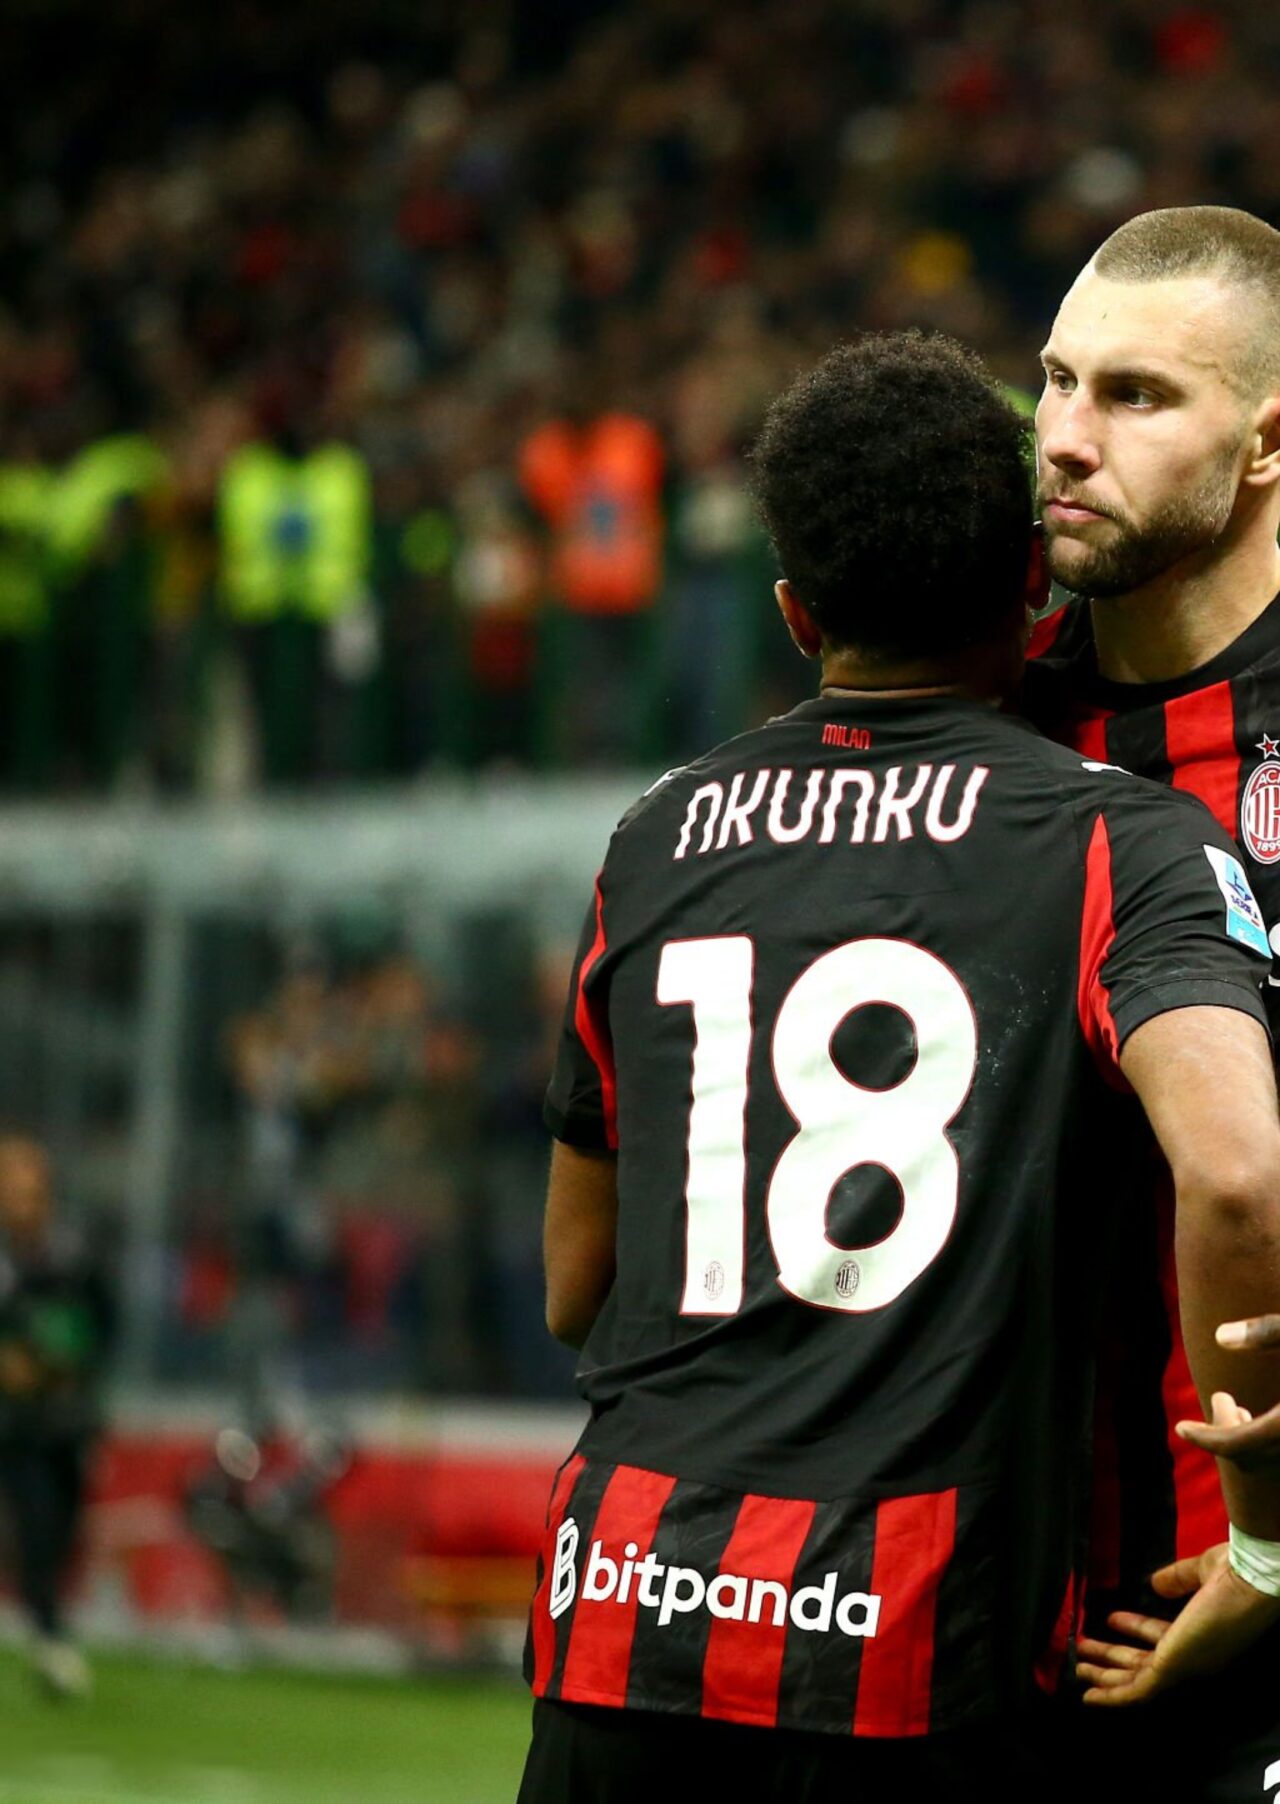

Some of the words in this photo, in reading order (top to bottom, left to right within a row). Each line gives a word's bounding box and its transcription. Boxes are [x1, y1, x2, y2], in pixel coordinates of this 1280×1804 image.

[821, 723, 871, 750] MILAN
[673, 764, 990, 860] NKUNKU
[656, 934, 979, 1317] 18
[581, 1540, 882, 1638] bitpanda
